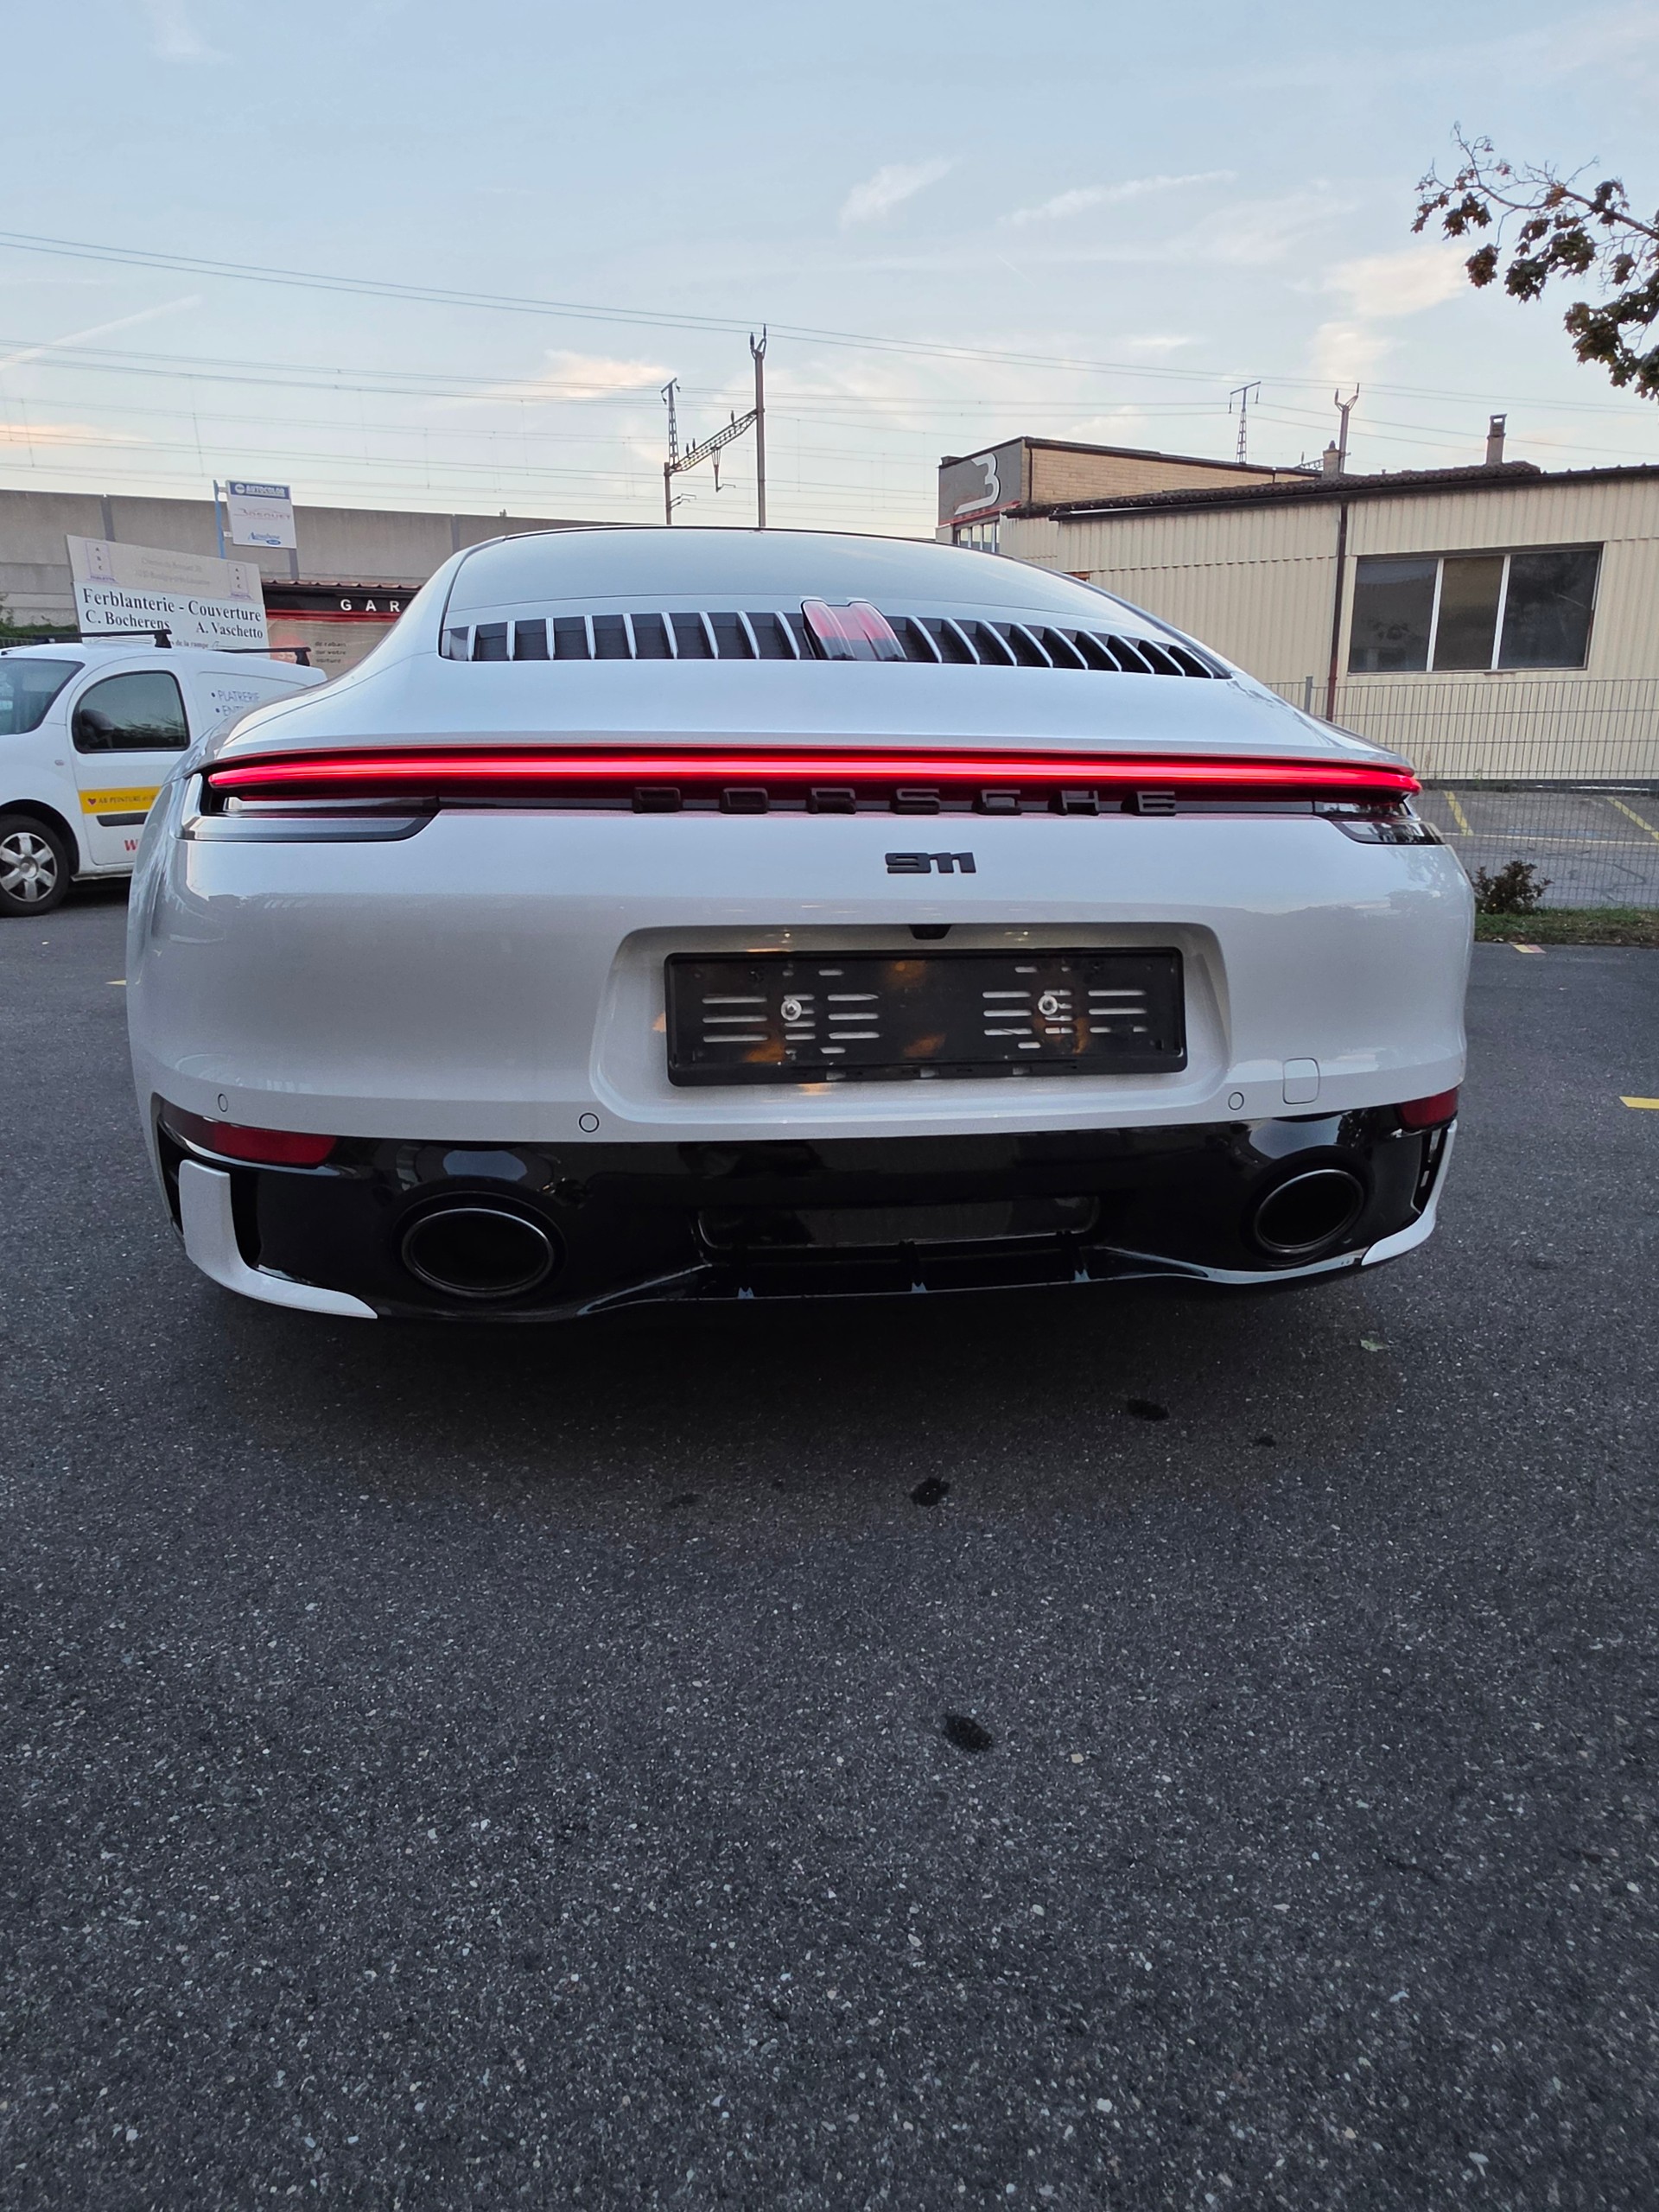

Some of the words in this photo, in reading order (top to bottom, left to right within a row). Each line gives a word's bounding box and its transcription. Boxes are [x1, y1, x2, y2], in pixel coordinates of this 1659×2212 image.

[83, 588, 175, 613] Ferblanterie
[188, 601, 262, 622] Couverture
[86, 610, 102, 624] C.
[105, 611, 170, 630] Bocherens
[196, 622, 209, 634] A.
[211, 621, 264, 639] Vaschetto
[632, 786, 1177, 816] PORSCHE
[884, 851, 976, 874] 911
